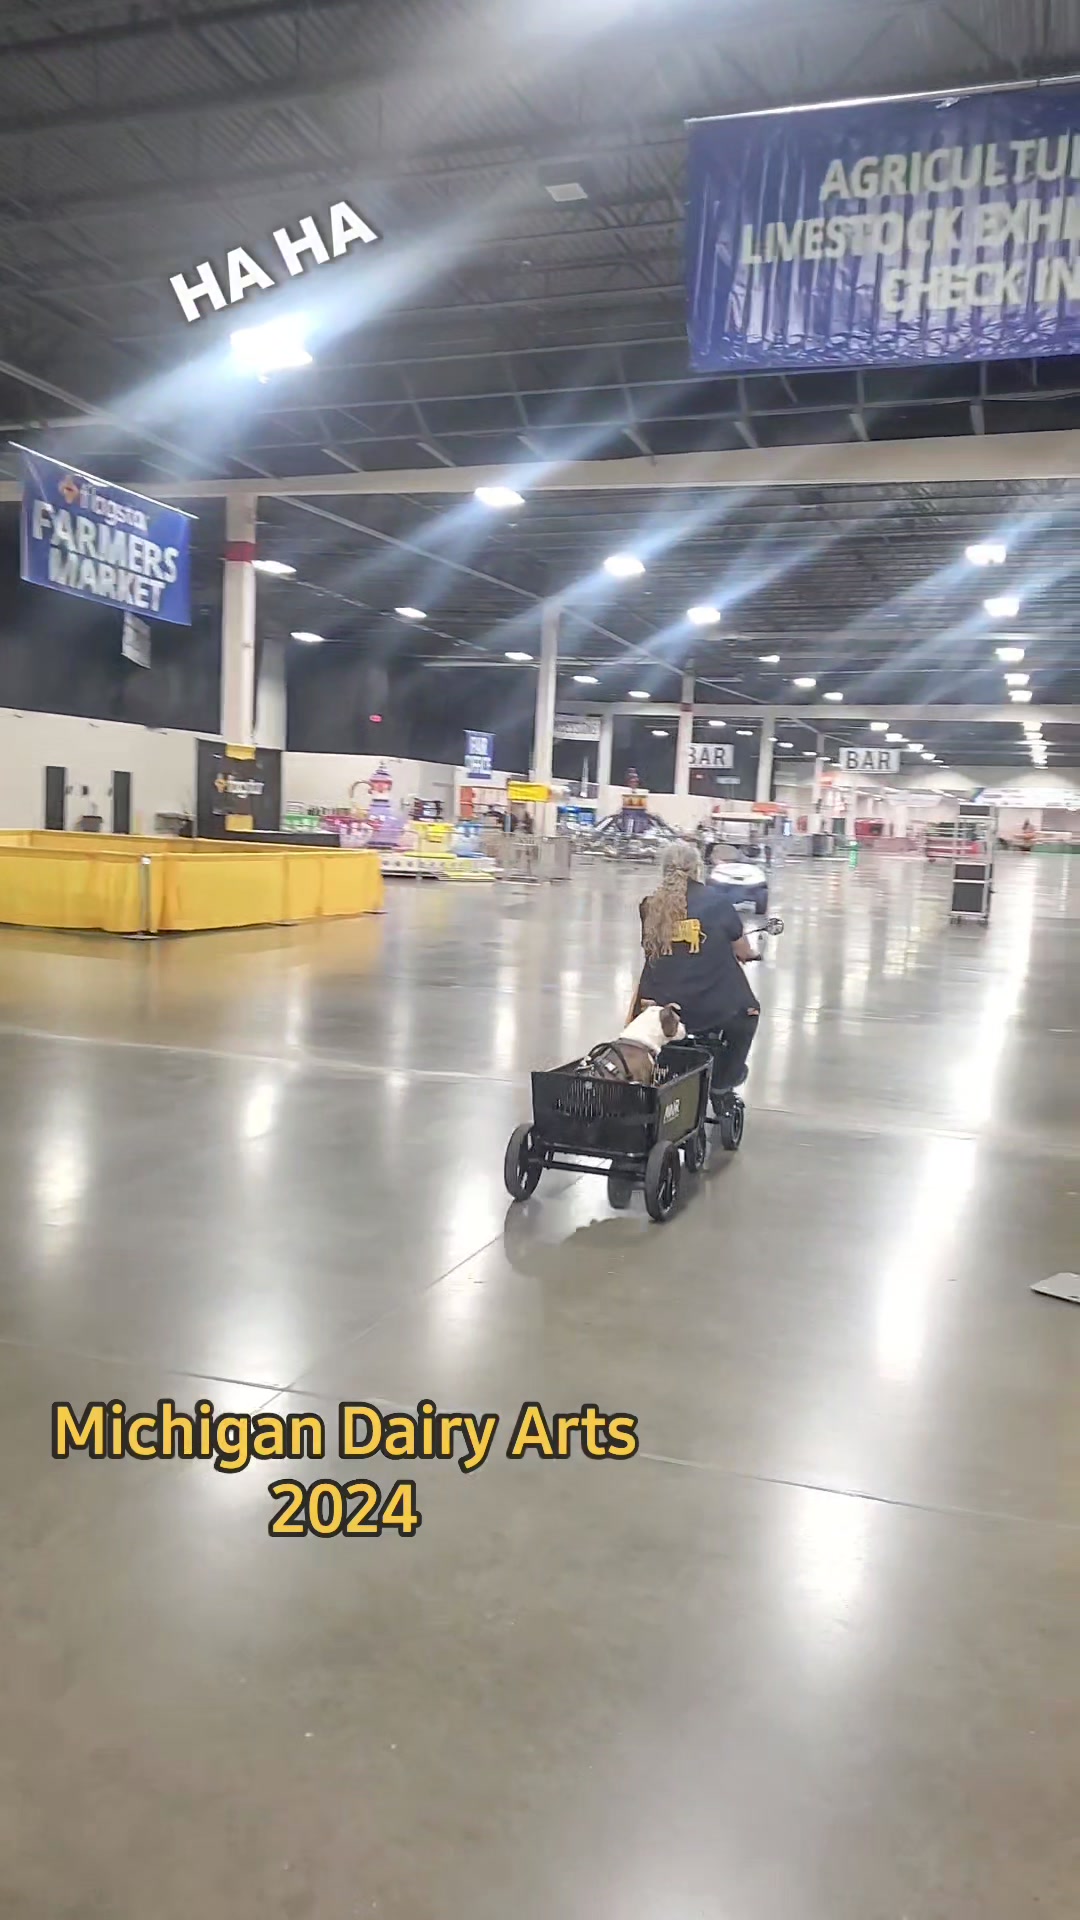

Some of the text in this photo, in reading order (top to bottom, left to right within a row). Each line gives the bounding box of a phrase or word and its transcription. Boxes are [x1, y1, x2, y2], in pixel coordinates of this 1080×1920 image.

[741, 207, 964, 264] LIVESTOCK
[881, 262, 1020, 312] CHECK
[32, 499, 180, 584] FARMERS
[48, 546, 167, 613] MARKET
[846, 750, 890, 770] BAR
